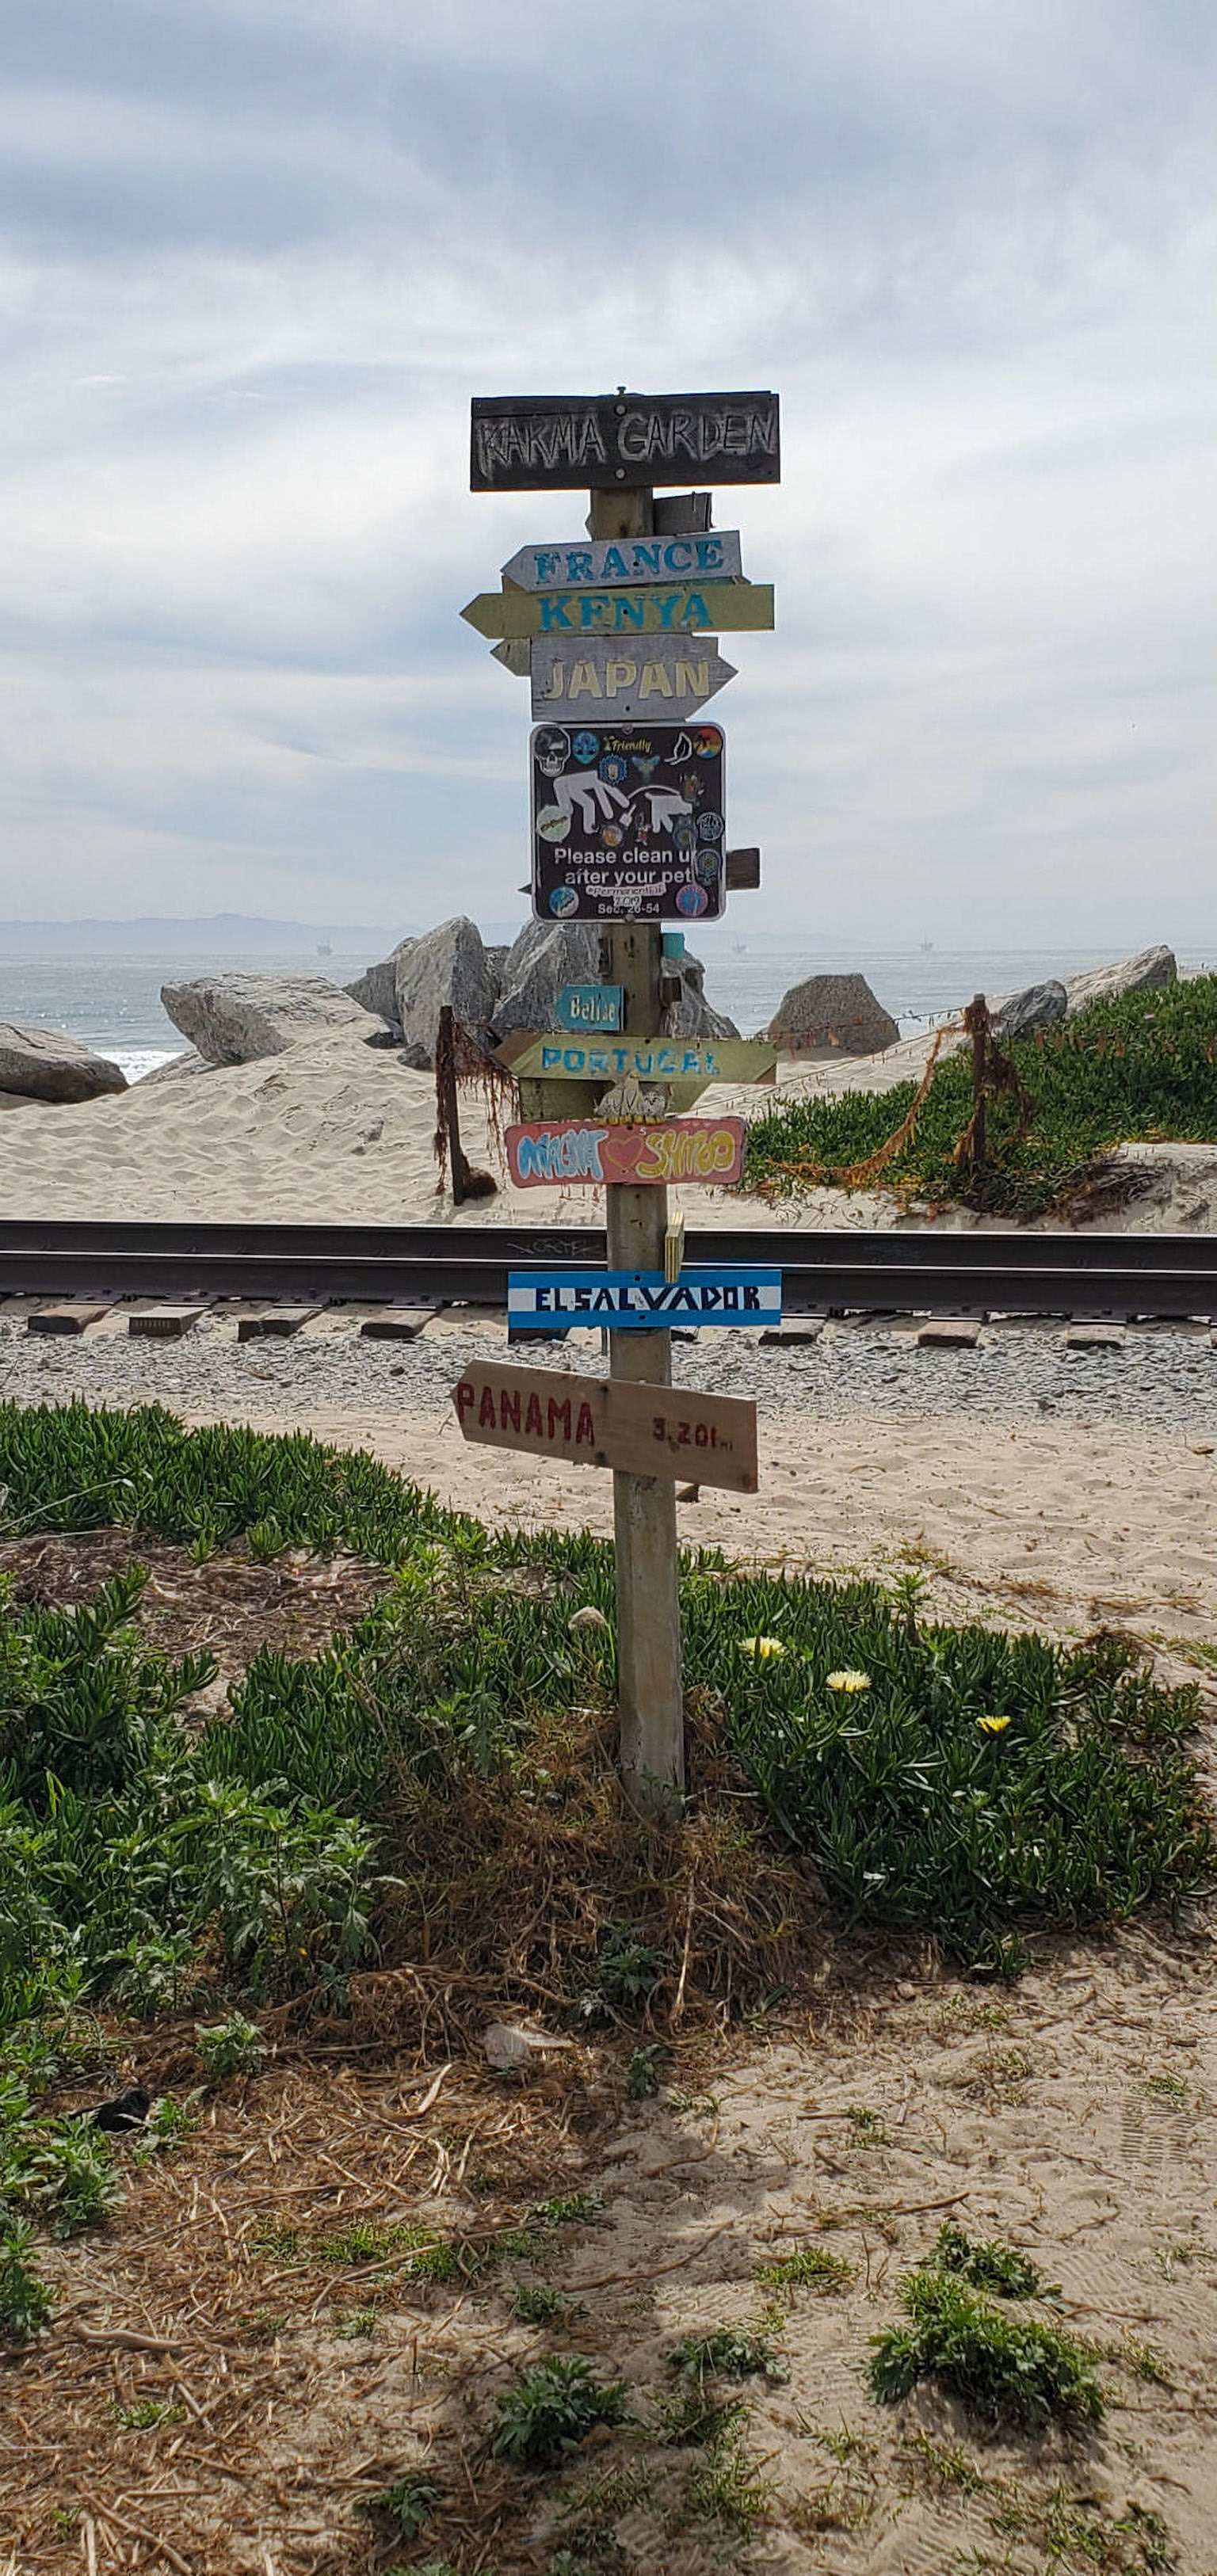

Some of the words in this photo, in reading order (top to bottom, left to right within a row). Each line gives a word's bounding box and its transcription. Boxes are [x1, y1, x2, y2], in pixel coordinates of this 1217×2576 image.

[478, 412, 606, 478] KARMA
[618, 410, 776, 462] GARDEN
[534, 539, 724, 585] FRANCE
[537, 593, 713, 631] KENYA
[543, 658, 710, 701] JAPAN
[555, 848, 616, 864] Please
[623, 848, 672, 864] clean
[679, 850, 695, 866] u
[565, 869, 608, 885] after
[614, 872, 656, 886] your
[662, 868, 692, 885] pet
[542, 1045, 719, 1075] PORTUGAL
[457, 1382, 595, 1447] PANAMA
